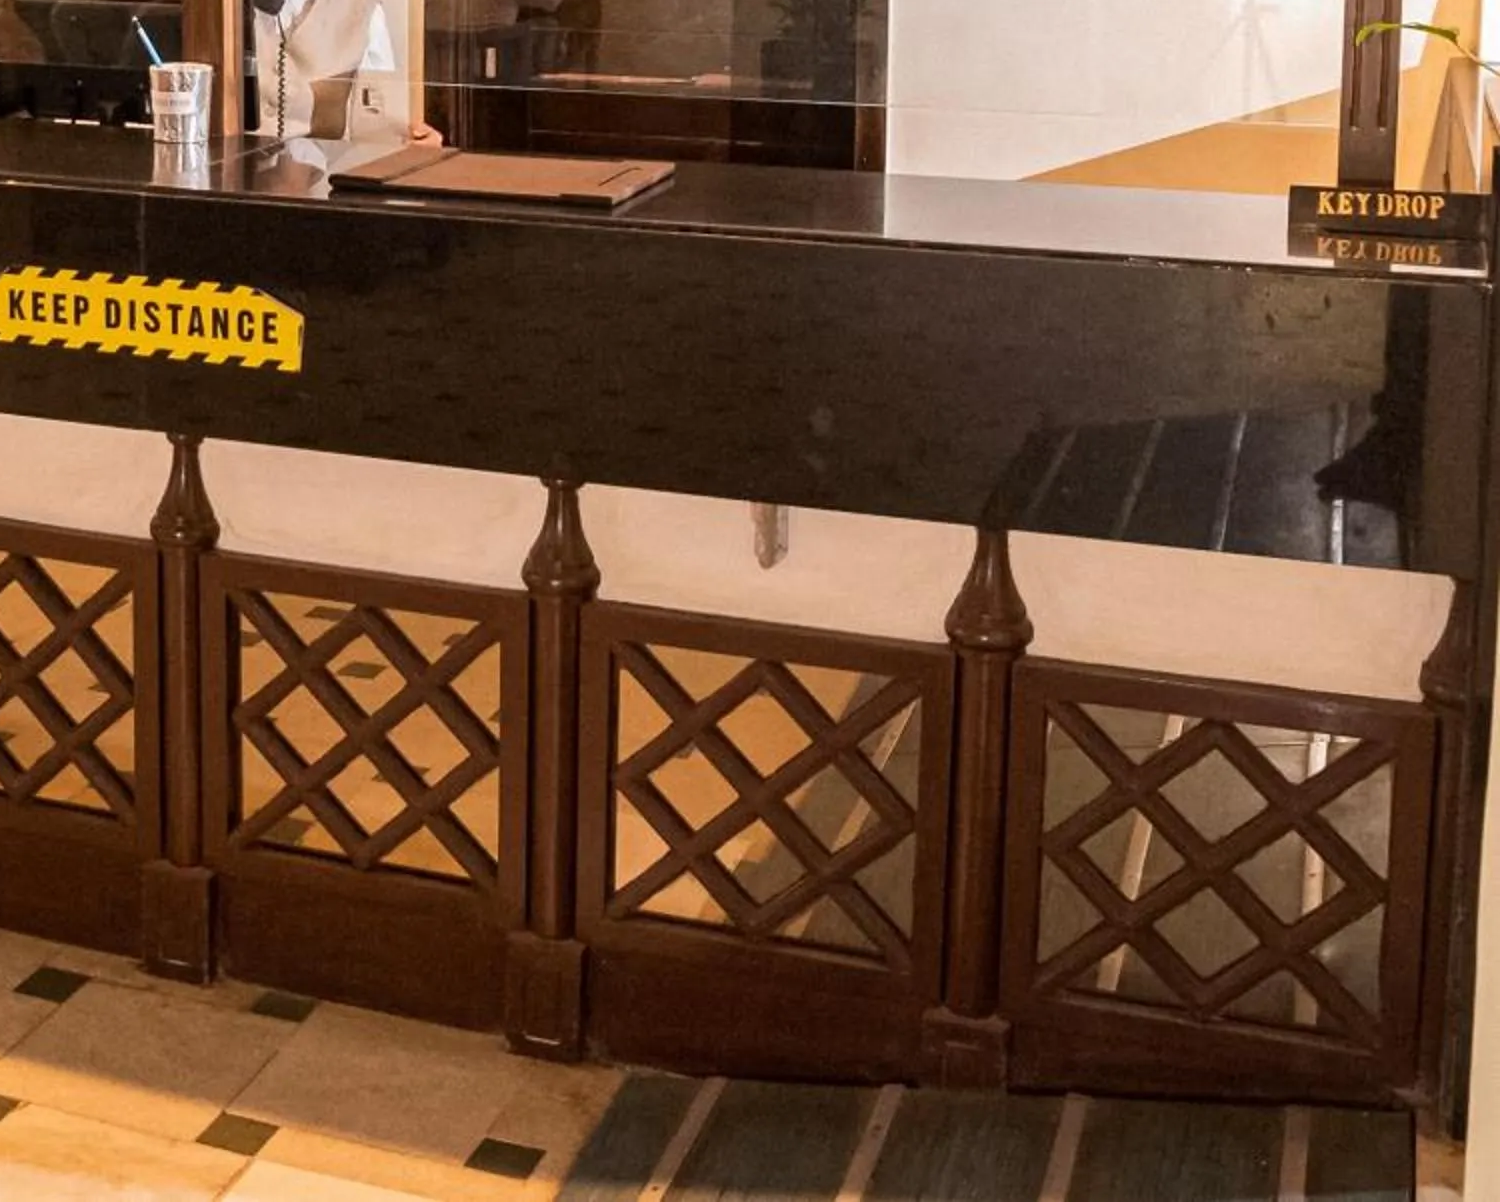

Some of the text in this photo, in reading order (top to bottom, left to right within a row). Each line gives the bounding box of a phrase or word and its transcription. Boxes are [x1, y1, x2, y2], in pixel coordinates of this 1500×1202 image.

[1318, 191, 1446, 220] KEY DROP
[8, 289, 279, 345] KEEP DISTANCE
